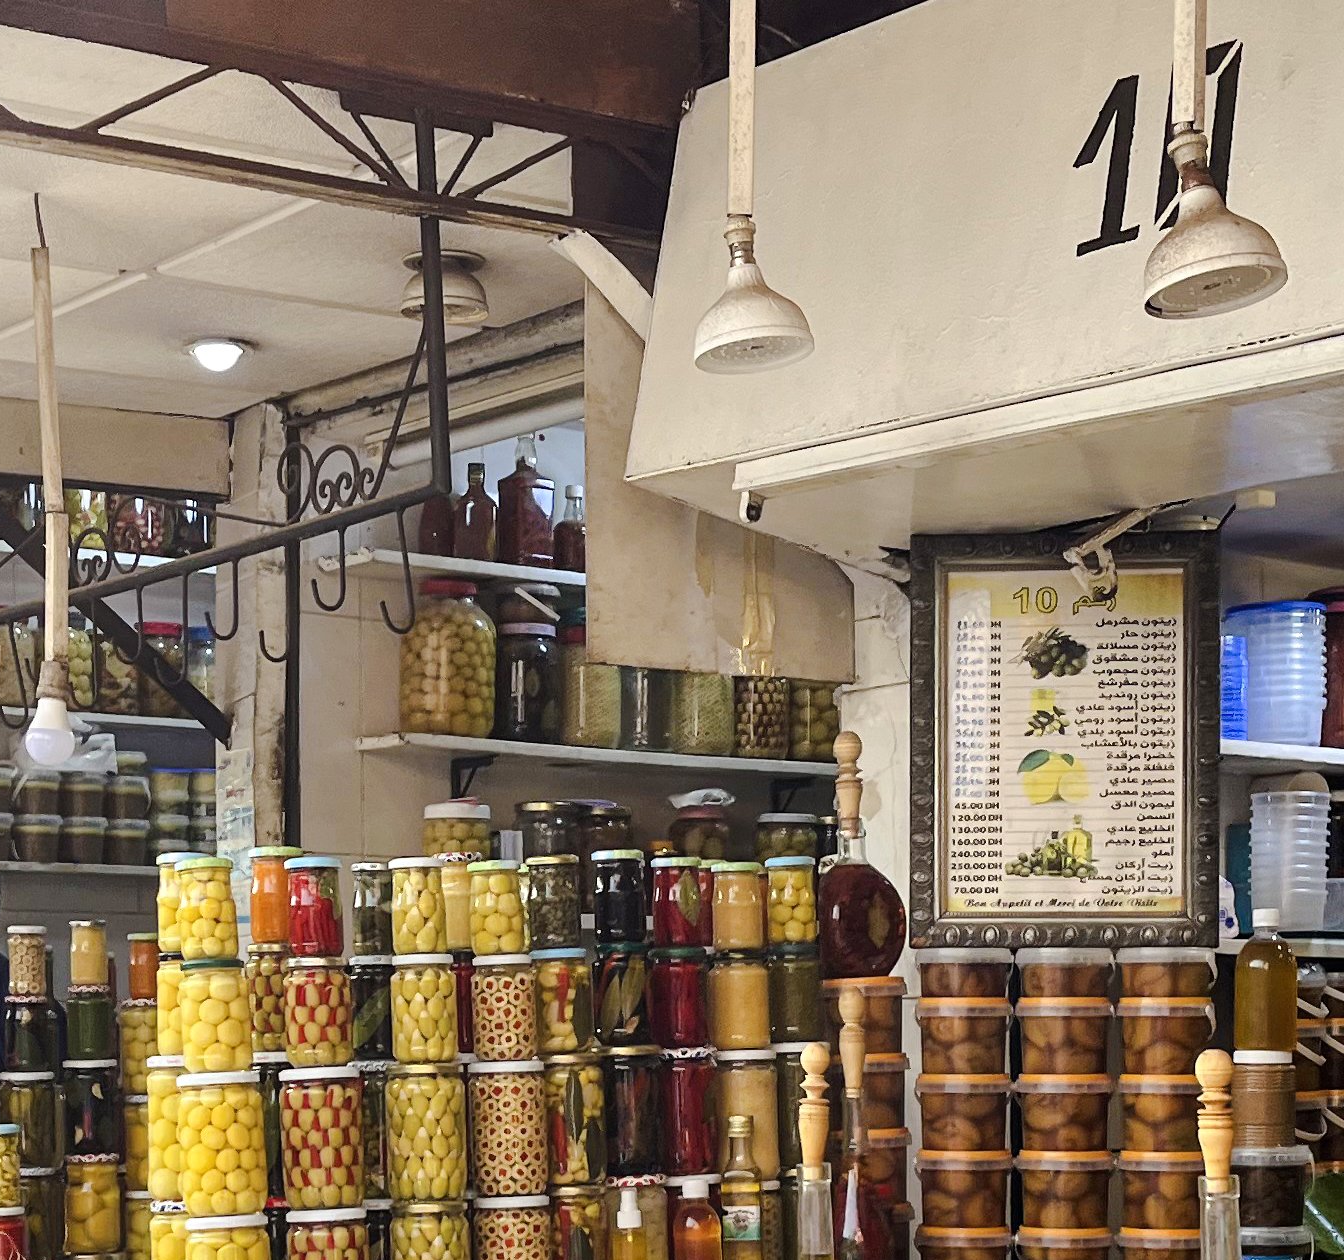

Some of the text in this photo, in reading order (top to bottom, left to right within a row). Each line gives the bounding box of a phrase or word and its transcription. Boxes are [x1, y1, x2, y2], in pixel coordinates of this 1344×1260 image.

[1013, 586, 1058, 614] 10
[1141, 617, 1177, 627] زيتون
[1141, 629, 1176, 639] زيتون
[1141, 641, 1176, 651] زيتون
[1141, 653, 1176, 663] زيتون
[1141, 666, 1176, 675] زيتون
[1141, 678, 1176, 688] زيتون
[1141, 690, 1176, 700] زيتون
[1108, 699, 1138, 712] أسود
[1141, 702, 1175, 712] زيتون
[1108, 711, 1138, 724] أسود
[1141, 714, 1175, 724] زيتون
[1108, 724, 1138, 737] أسود
[1140, 727, 1175, 737] زيتون
[1140, 739, 1175, 749] زيتون
[954, 802, 1000, 810] 45.00 DH
[952, 814, 1003, 822] 120.00 DH
[952, 826, 1003, 834] 130.00 DH
[952, 838, 1003, 846] 160.00 DH
[951, 850, 1003, 858] 240.00 DH
[951, 862, 1003, 870] 250.00 DH
[987, 874, 1003, 882] DH
[954, 887, 999, 895] 70.00 DH
[965, 898, 987, 907] Bon
[991, 898, 1032, 908] Appetit
[1035, 899, 1044, 907] et
[1047, 898, 1075, 908] Merci
[1079, 898, 1090, 907] de
[1093, 898, 1123, 907] Votre
